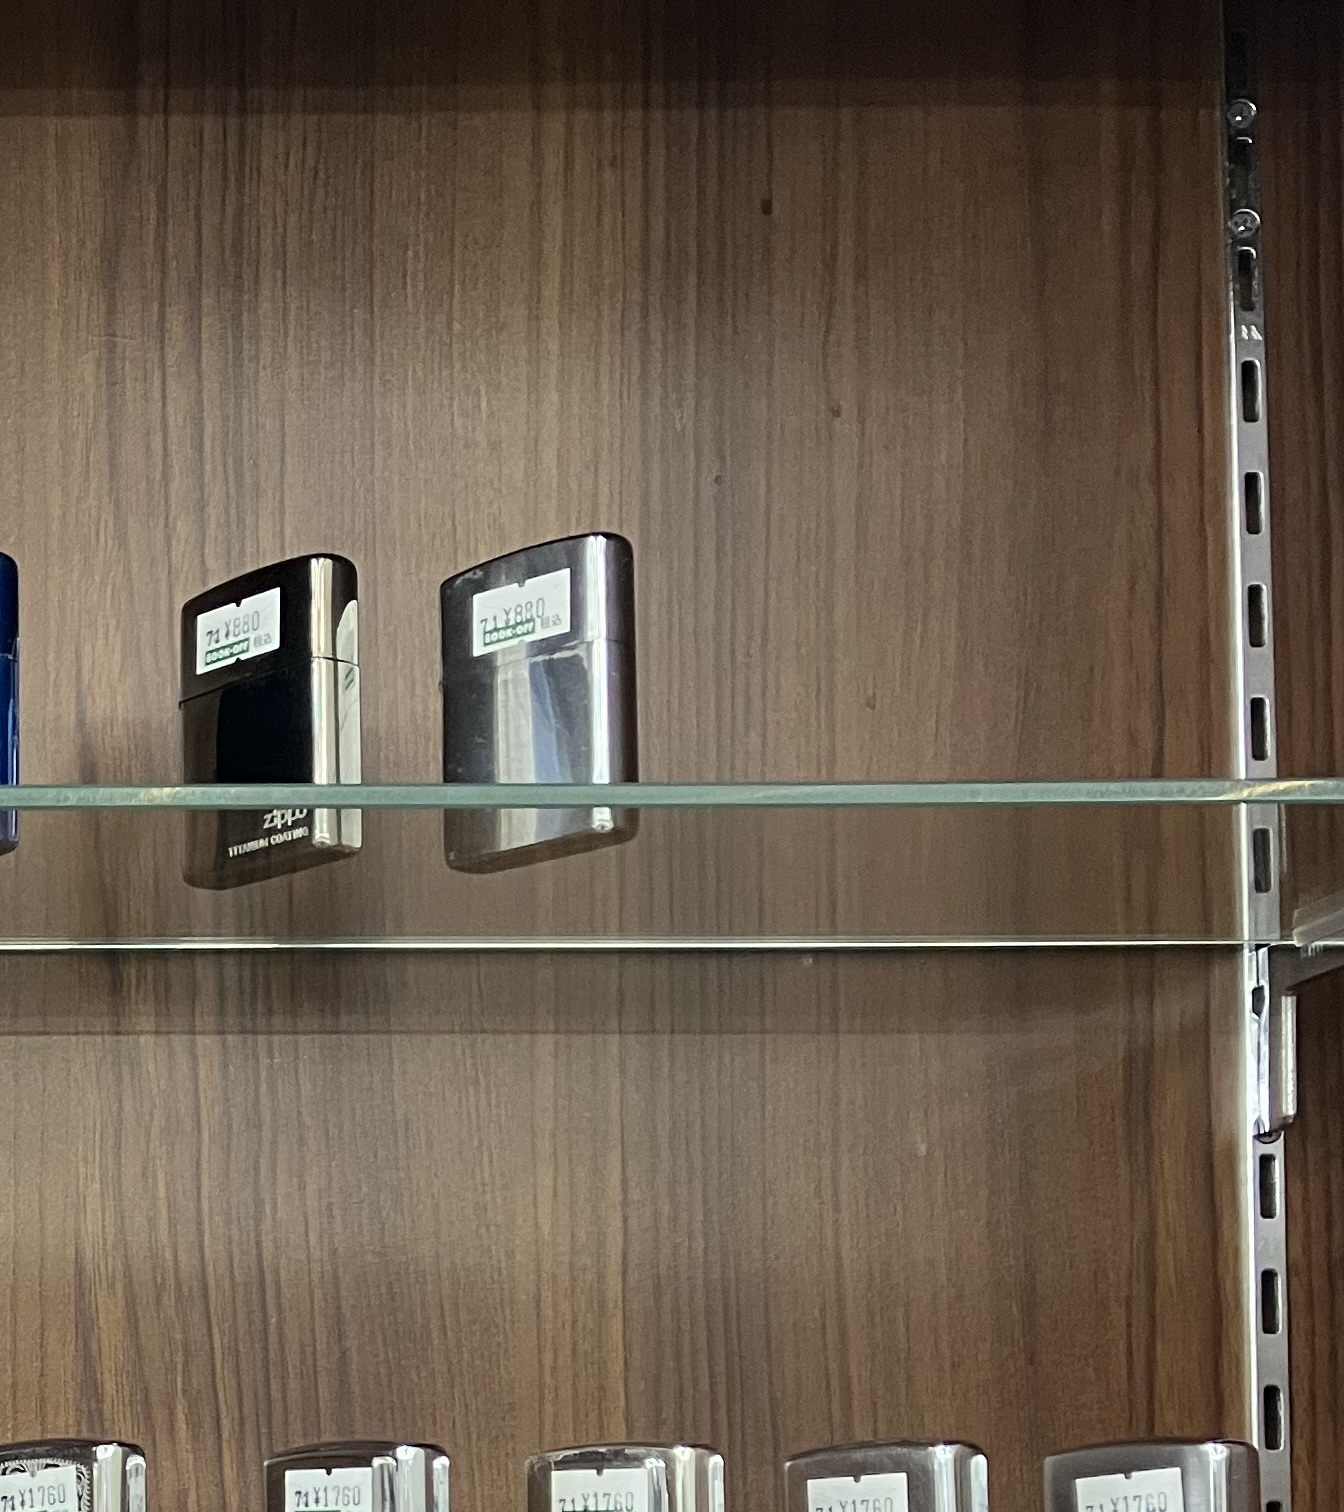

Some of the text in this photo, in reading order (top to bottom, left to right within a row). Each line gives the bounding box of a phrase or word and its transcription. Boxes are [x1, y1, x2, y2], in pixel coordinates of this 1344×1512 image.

[503, 598, 545, 626] ¥880
[224, 618, 260, 639] ¥880
[270, 826, 310, 845] COATING
[19, 1484, 66, 1510] ¥1760
[314, 1483, 360, 1507] ¥1760
[581, 1491, 634, 1512] ¥1760
